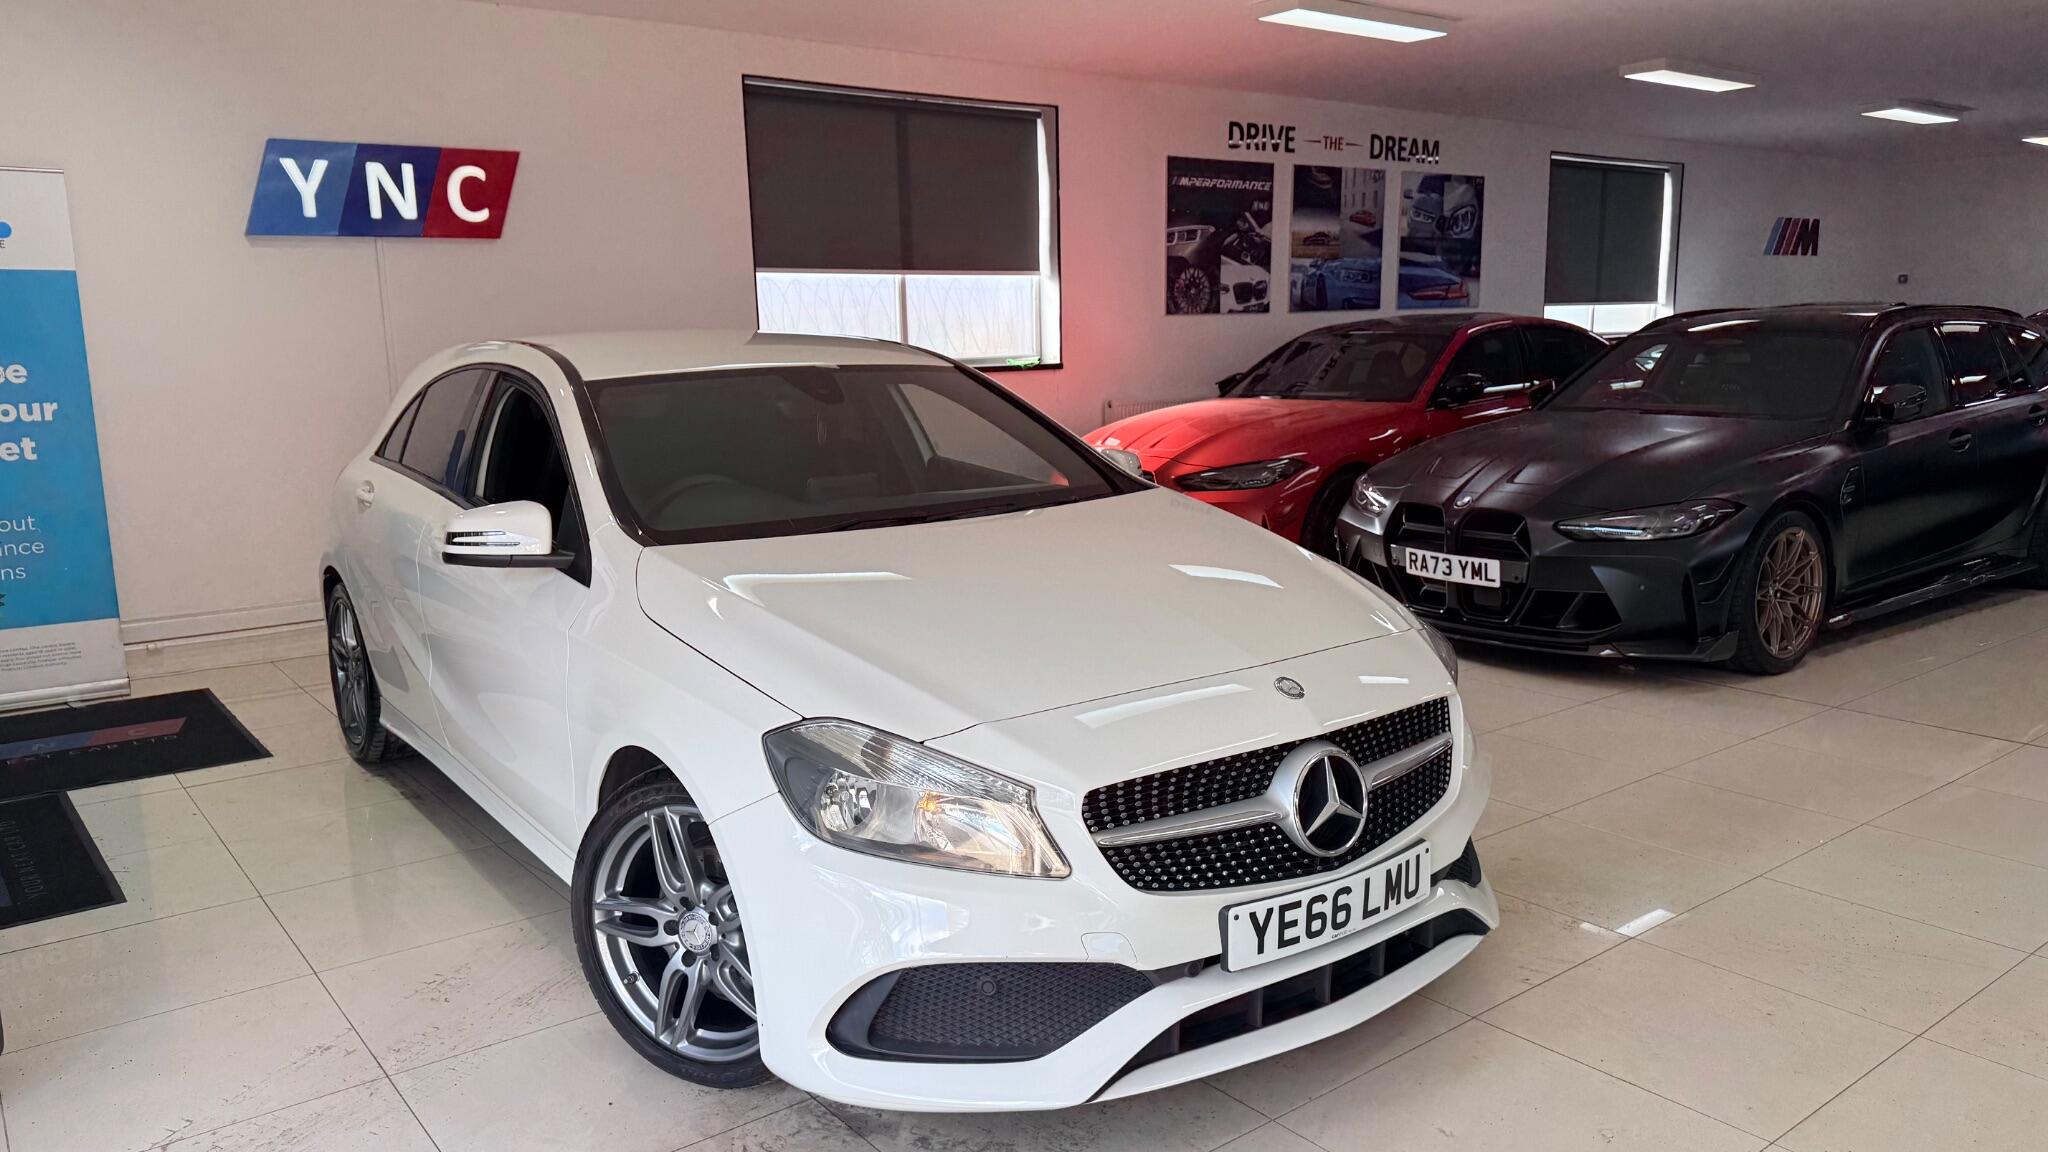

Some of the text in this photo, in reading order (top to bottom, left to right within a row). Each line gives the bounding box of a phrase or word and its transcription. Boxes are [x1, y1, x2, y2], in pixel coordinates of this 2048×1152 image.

[1228, 121, 1440, 165] DRIVE THE DREAM
[279, 157, 490, 223] YNC
[0, 364, 28, 384] e
[0, 541, 45, 556] nce
[1408, 551, 1497, 583] RA73 YML
[1248, 853, 1421, 956] YE66 LMU
